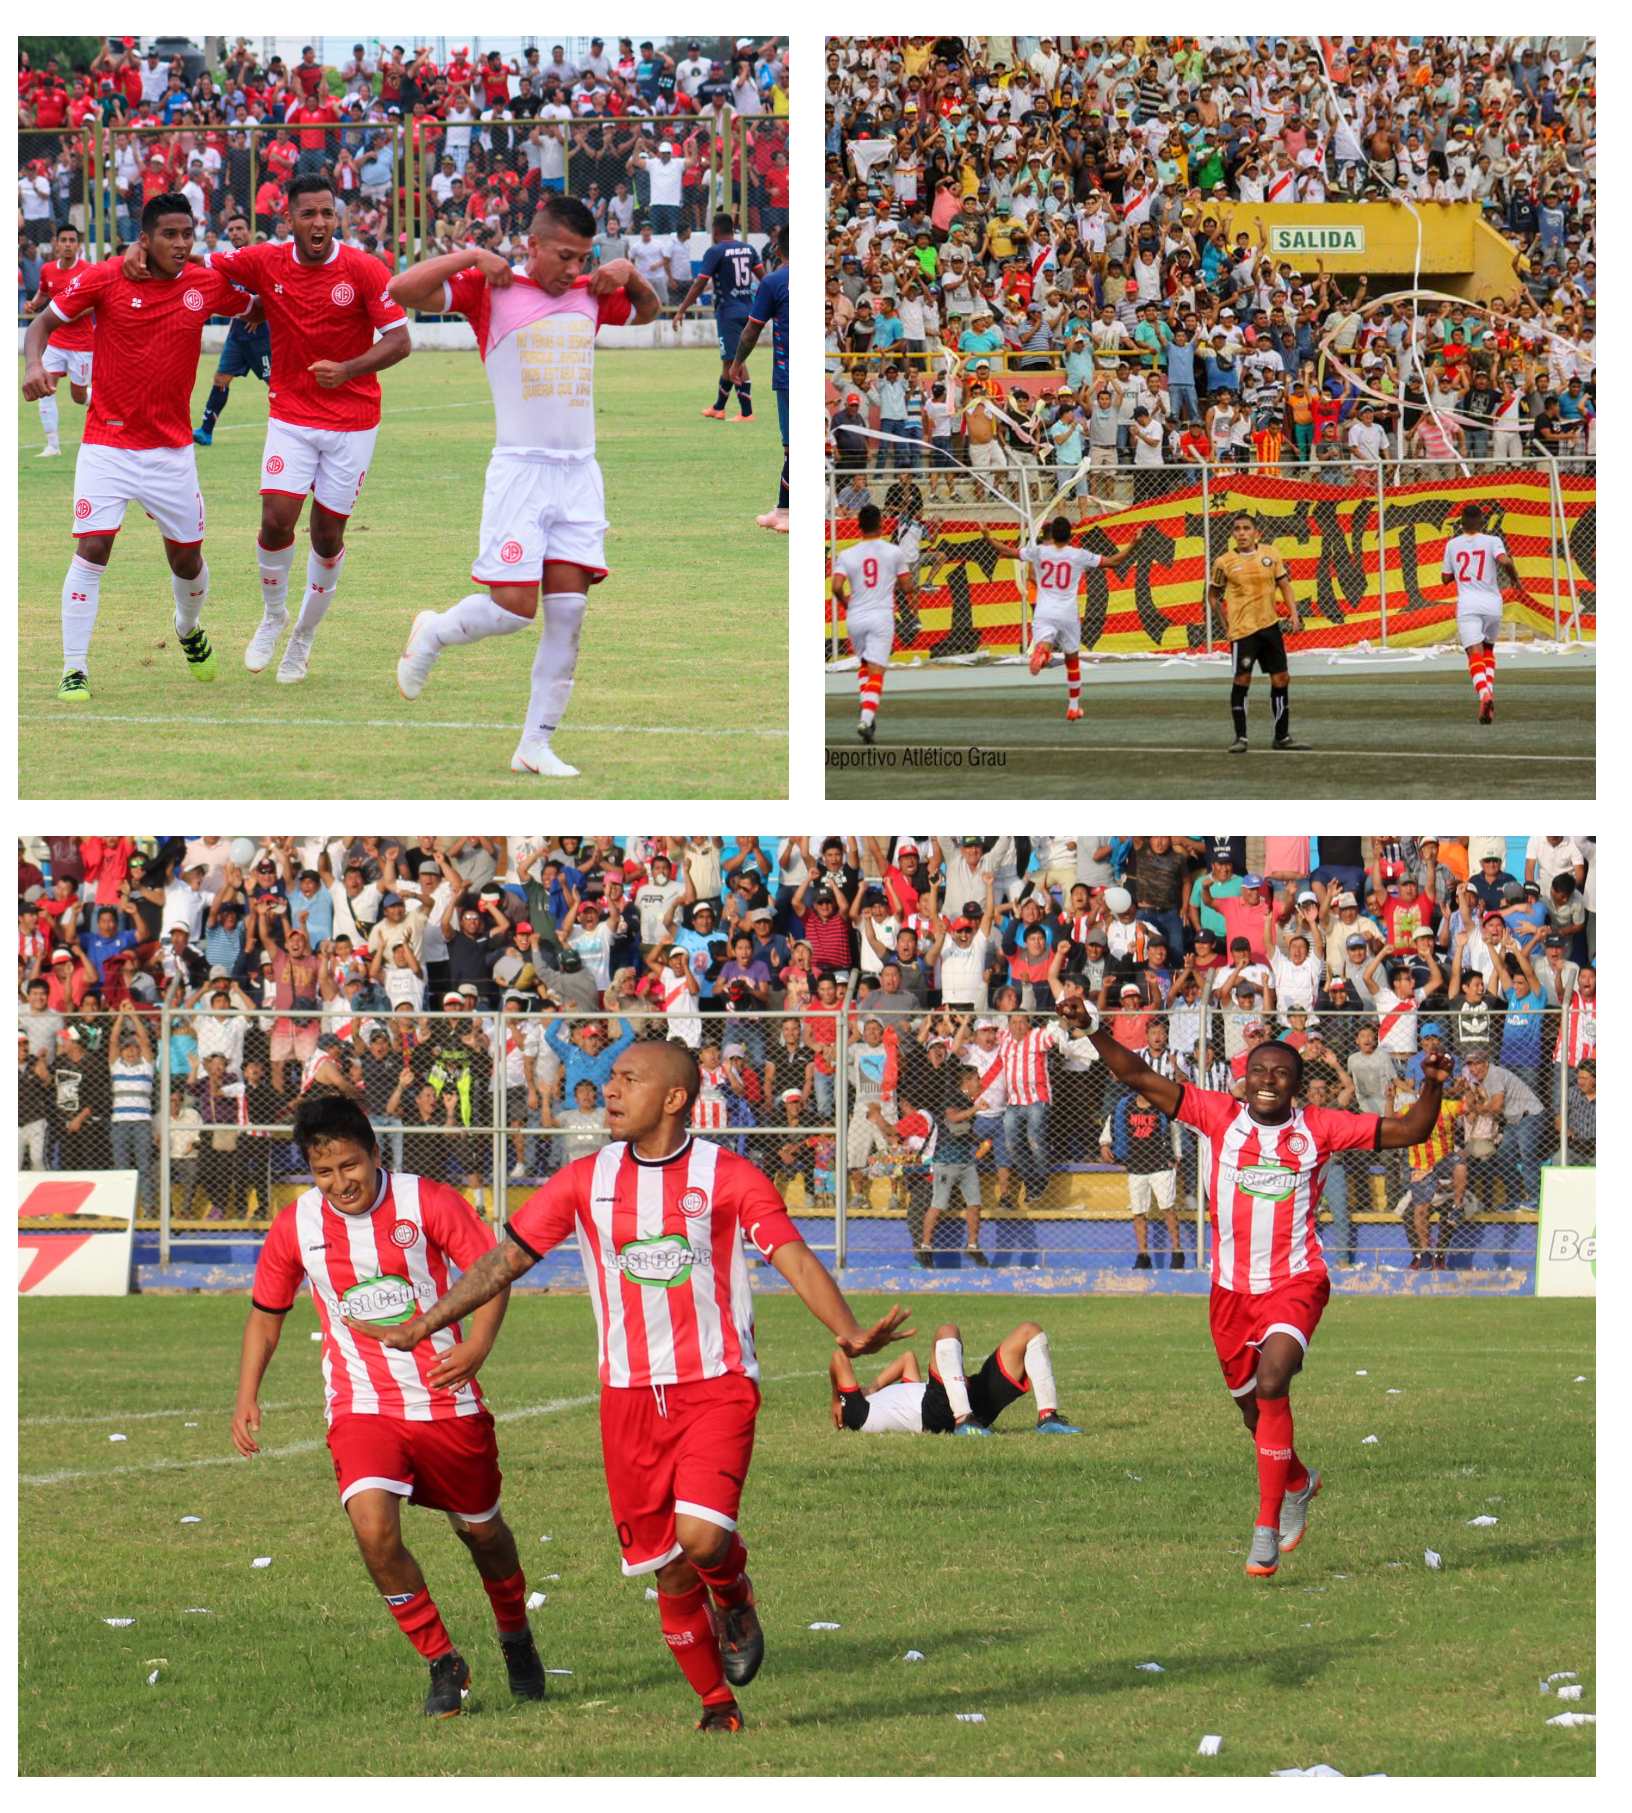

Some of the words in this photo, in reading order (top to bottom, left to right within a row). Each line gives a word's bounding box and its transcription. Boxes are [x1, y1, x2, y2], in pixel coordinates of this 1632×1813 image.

[1279, 231, 1357, 248] SALIDA
[732, 257, 751, 287] 15
[862, 557, 879, 588] 9
[1039, 560, 1072, 589] 20
[1455, 551, 1487, 583] 27
[1130, 1113, 1157, 1126] NIKE
